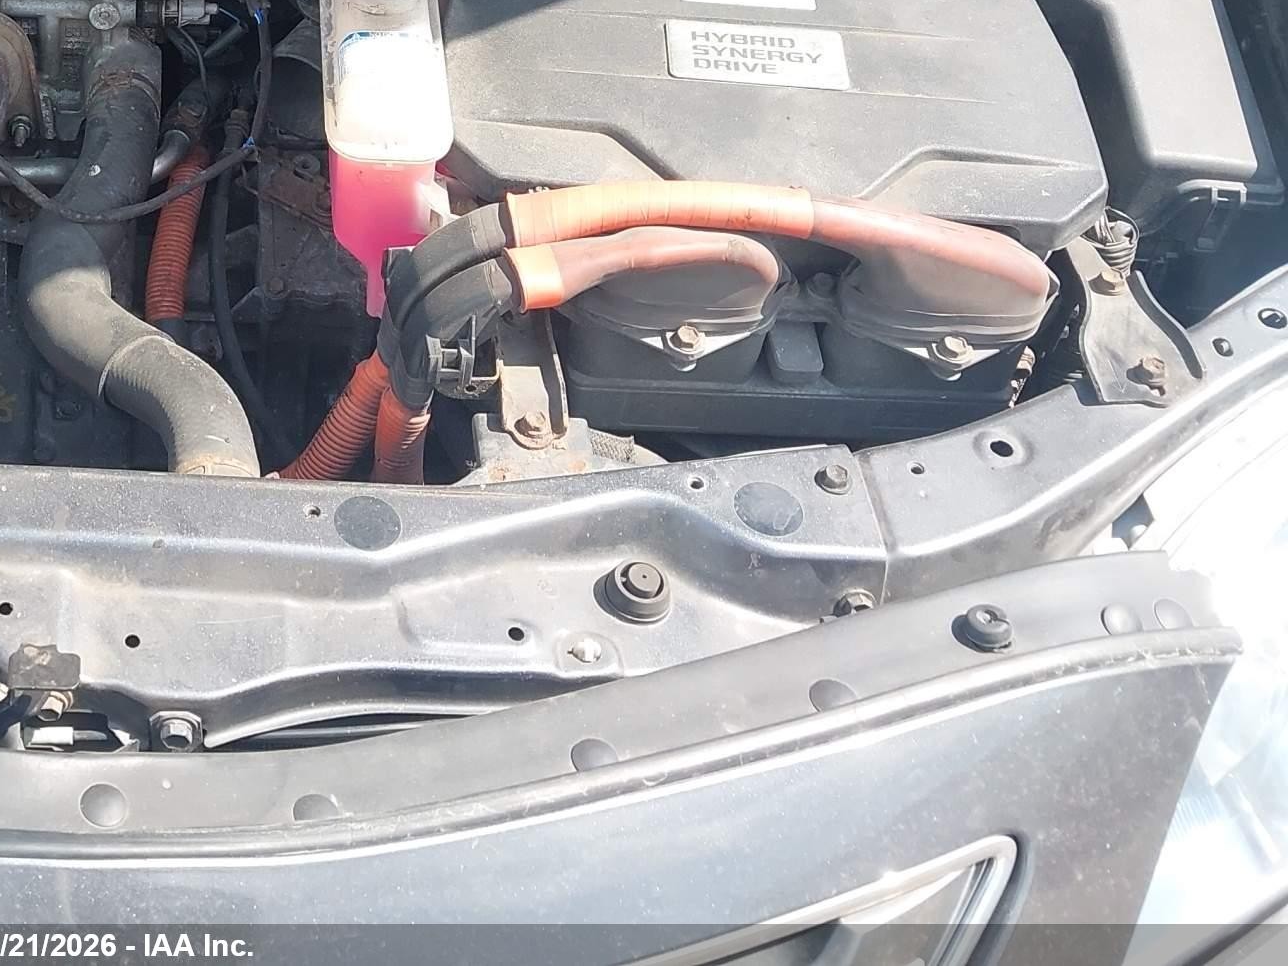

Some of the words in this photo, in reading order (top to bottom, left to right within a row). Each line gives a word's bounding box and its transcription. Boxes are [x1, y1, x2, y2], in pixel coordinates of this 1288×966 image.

[691, 31, 796, 49] HYBRID
[692, 44, 823, 64] SYNERGY
[693, 58, 780, 75] DRIVE
